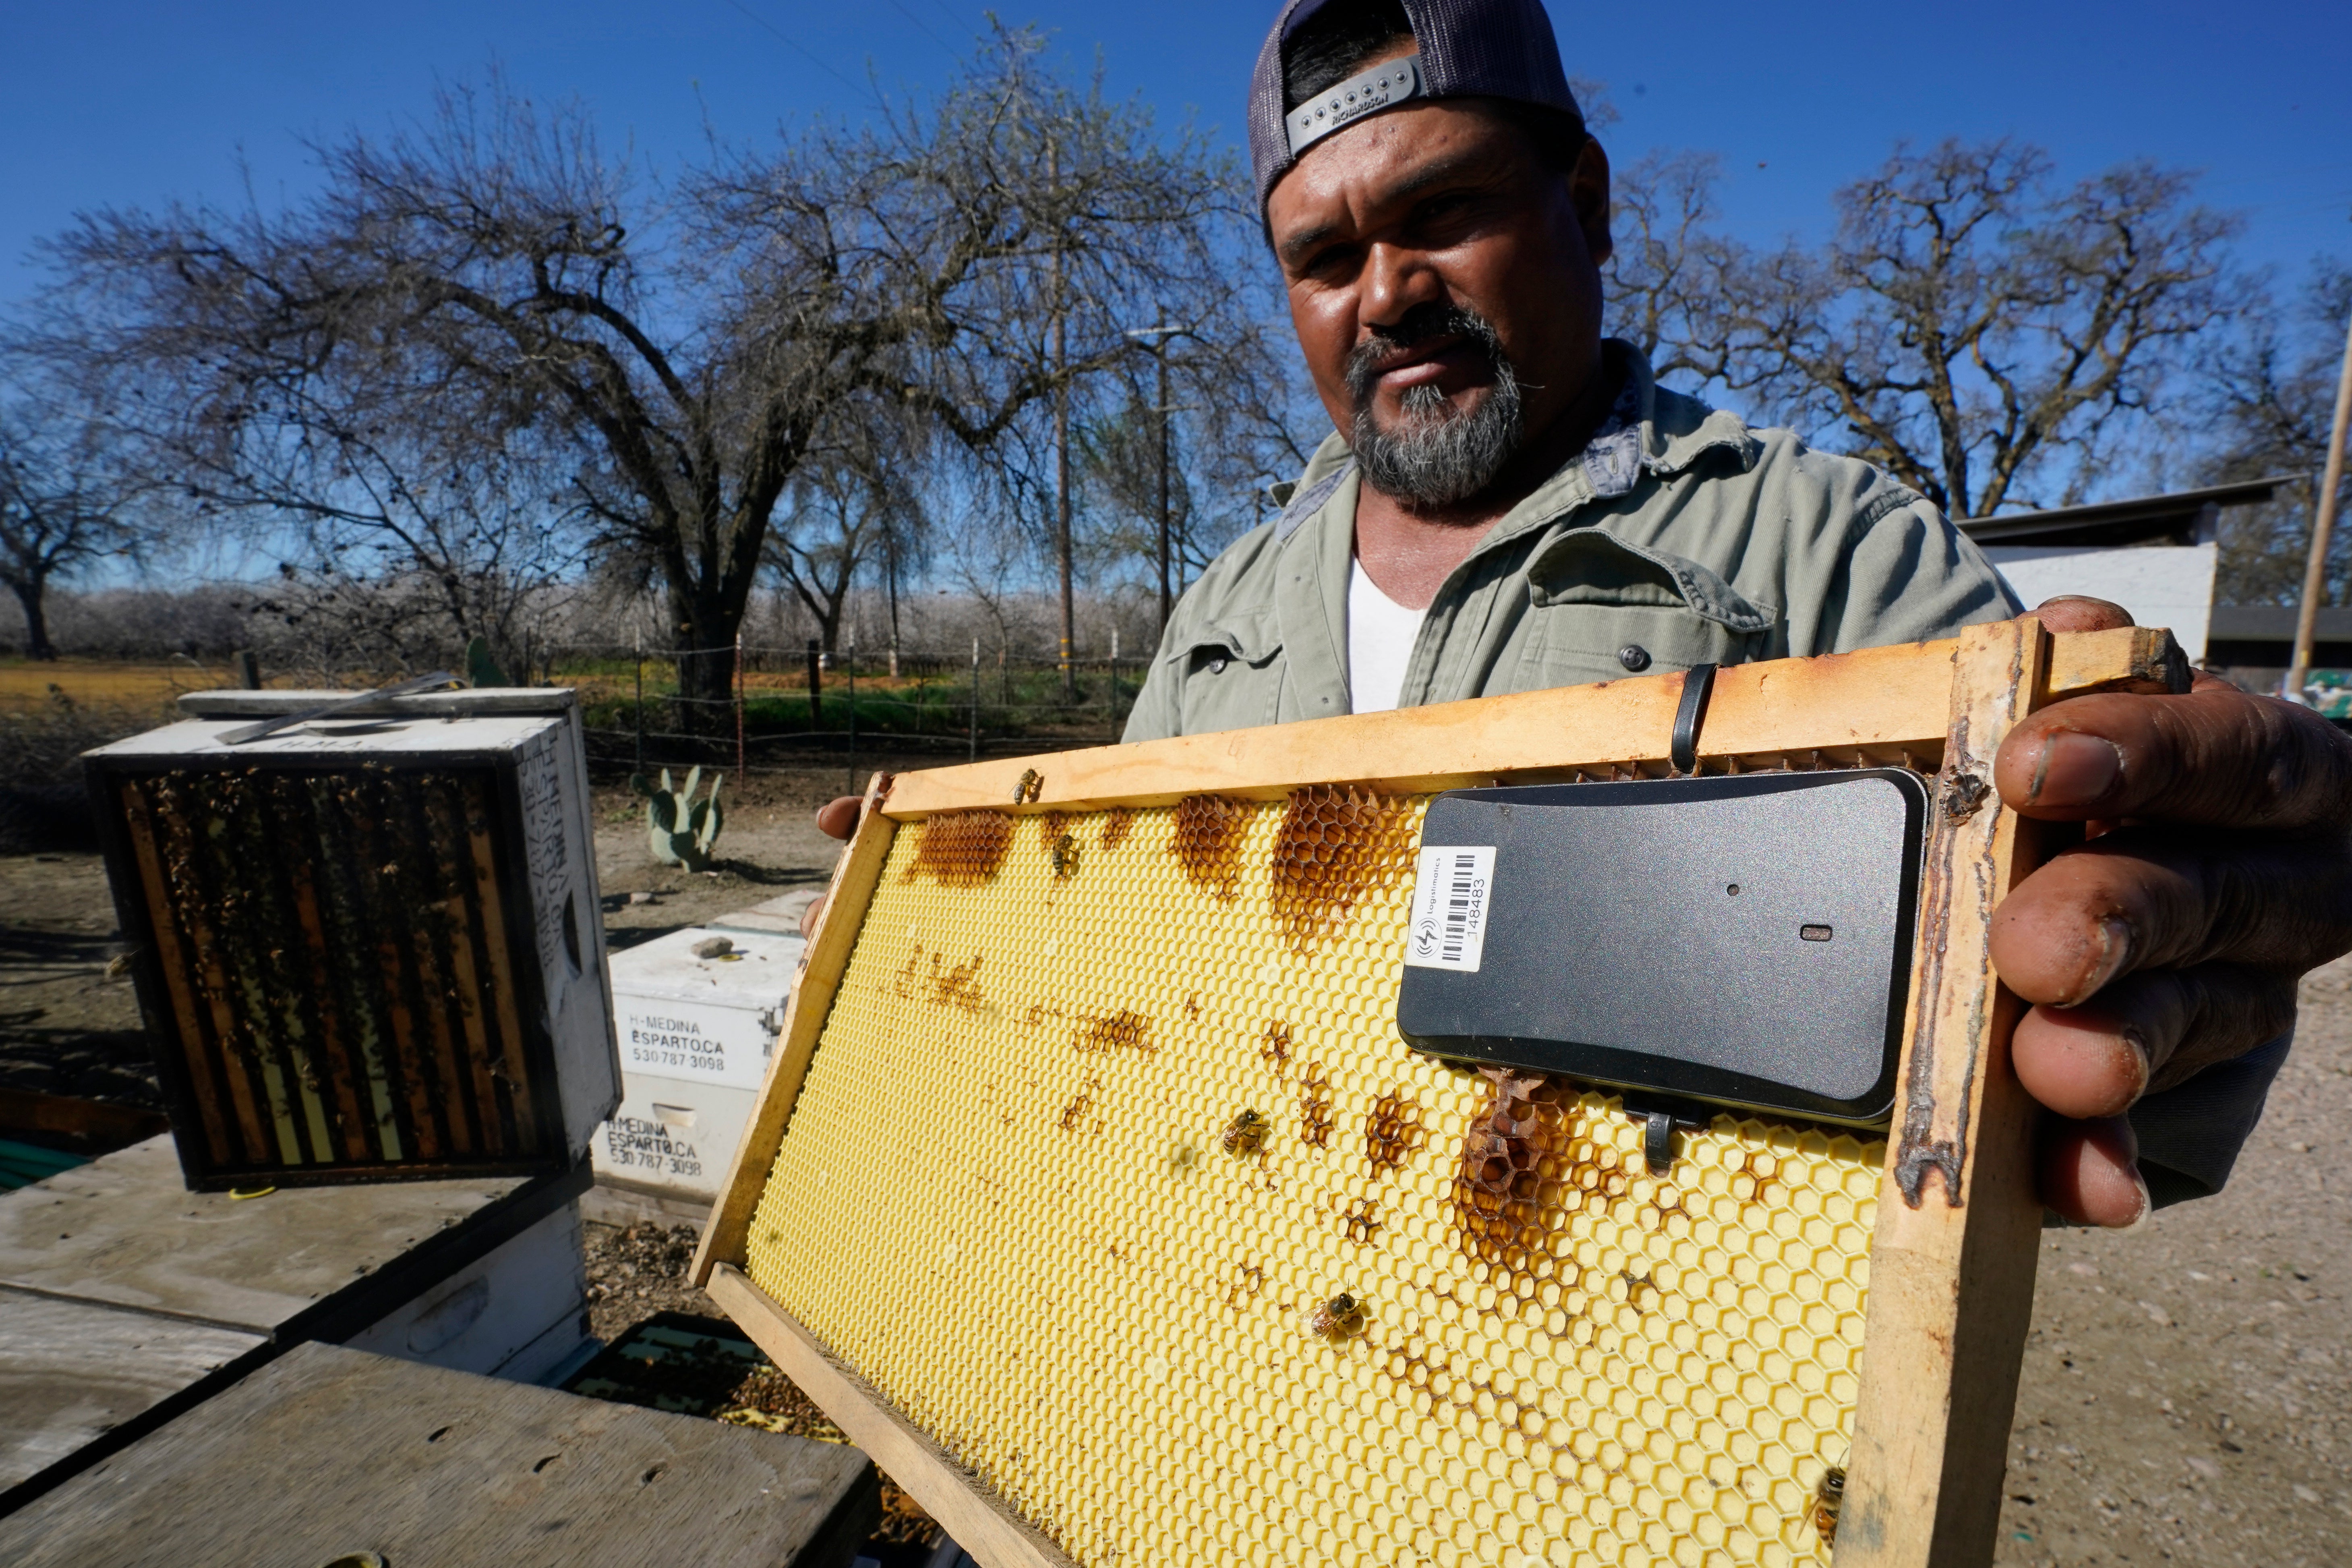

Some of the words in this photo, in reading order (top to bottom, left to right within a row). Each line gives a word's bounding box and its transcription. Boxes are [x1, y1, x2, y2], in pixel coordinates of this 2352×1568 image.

[1331, 93, 1389, 126] RICHARDSON
[1427, 858, 1441, 914] Logistimatics
[1467, 879, 1484, 937] 148483
